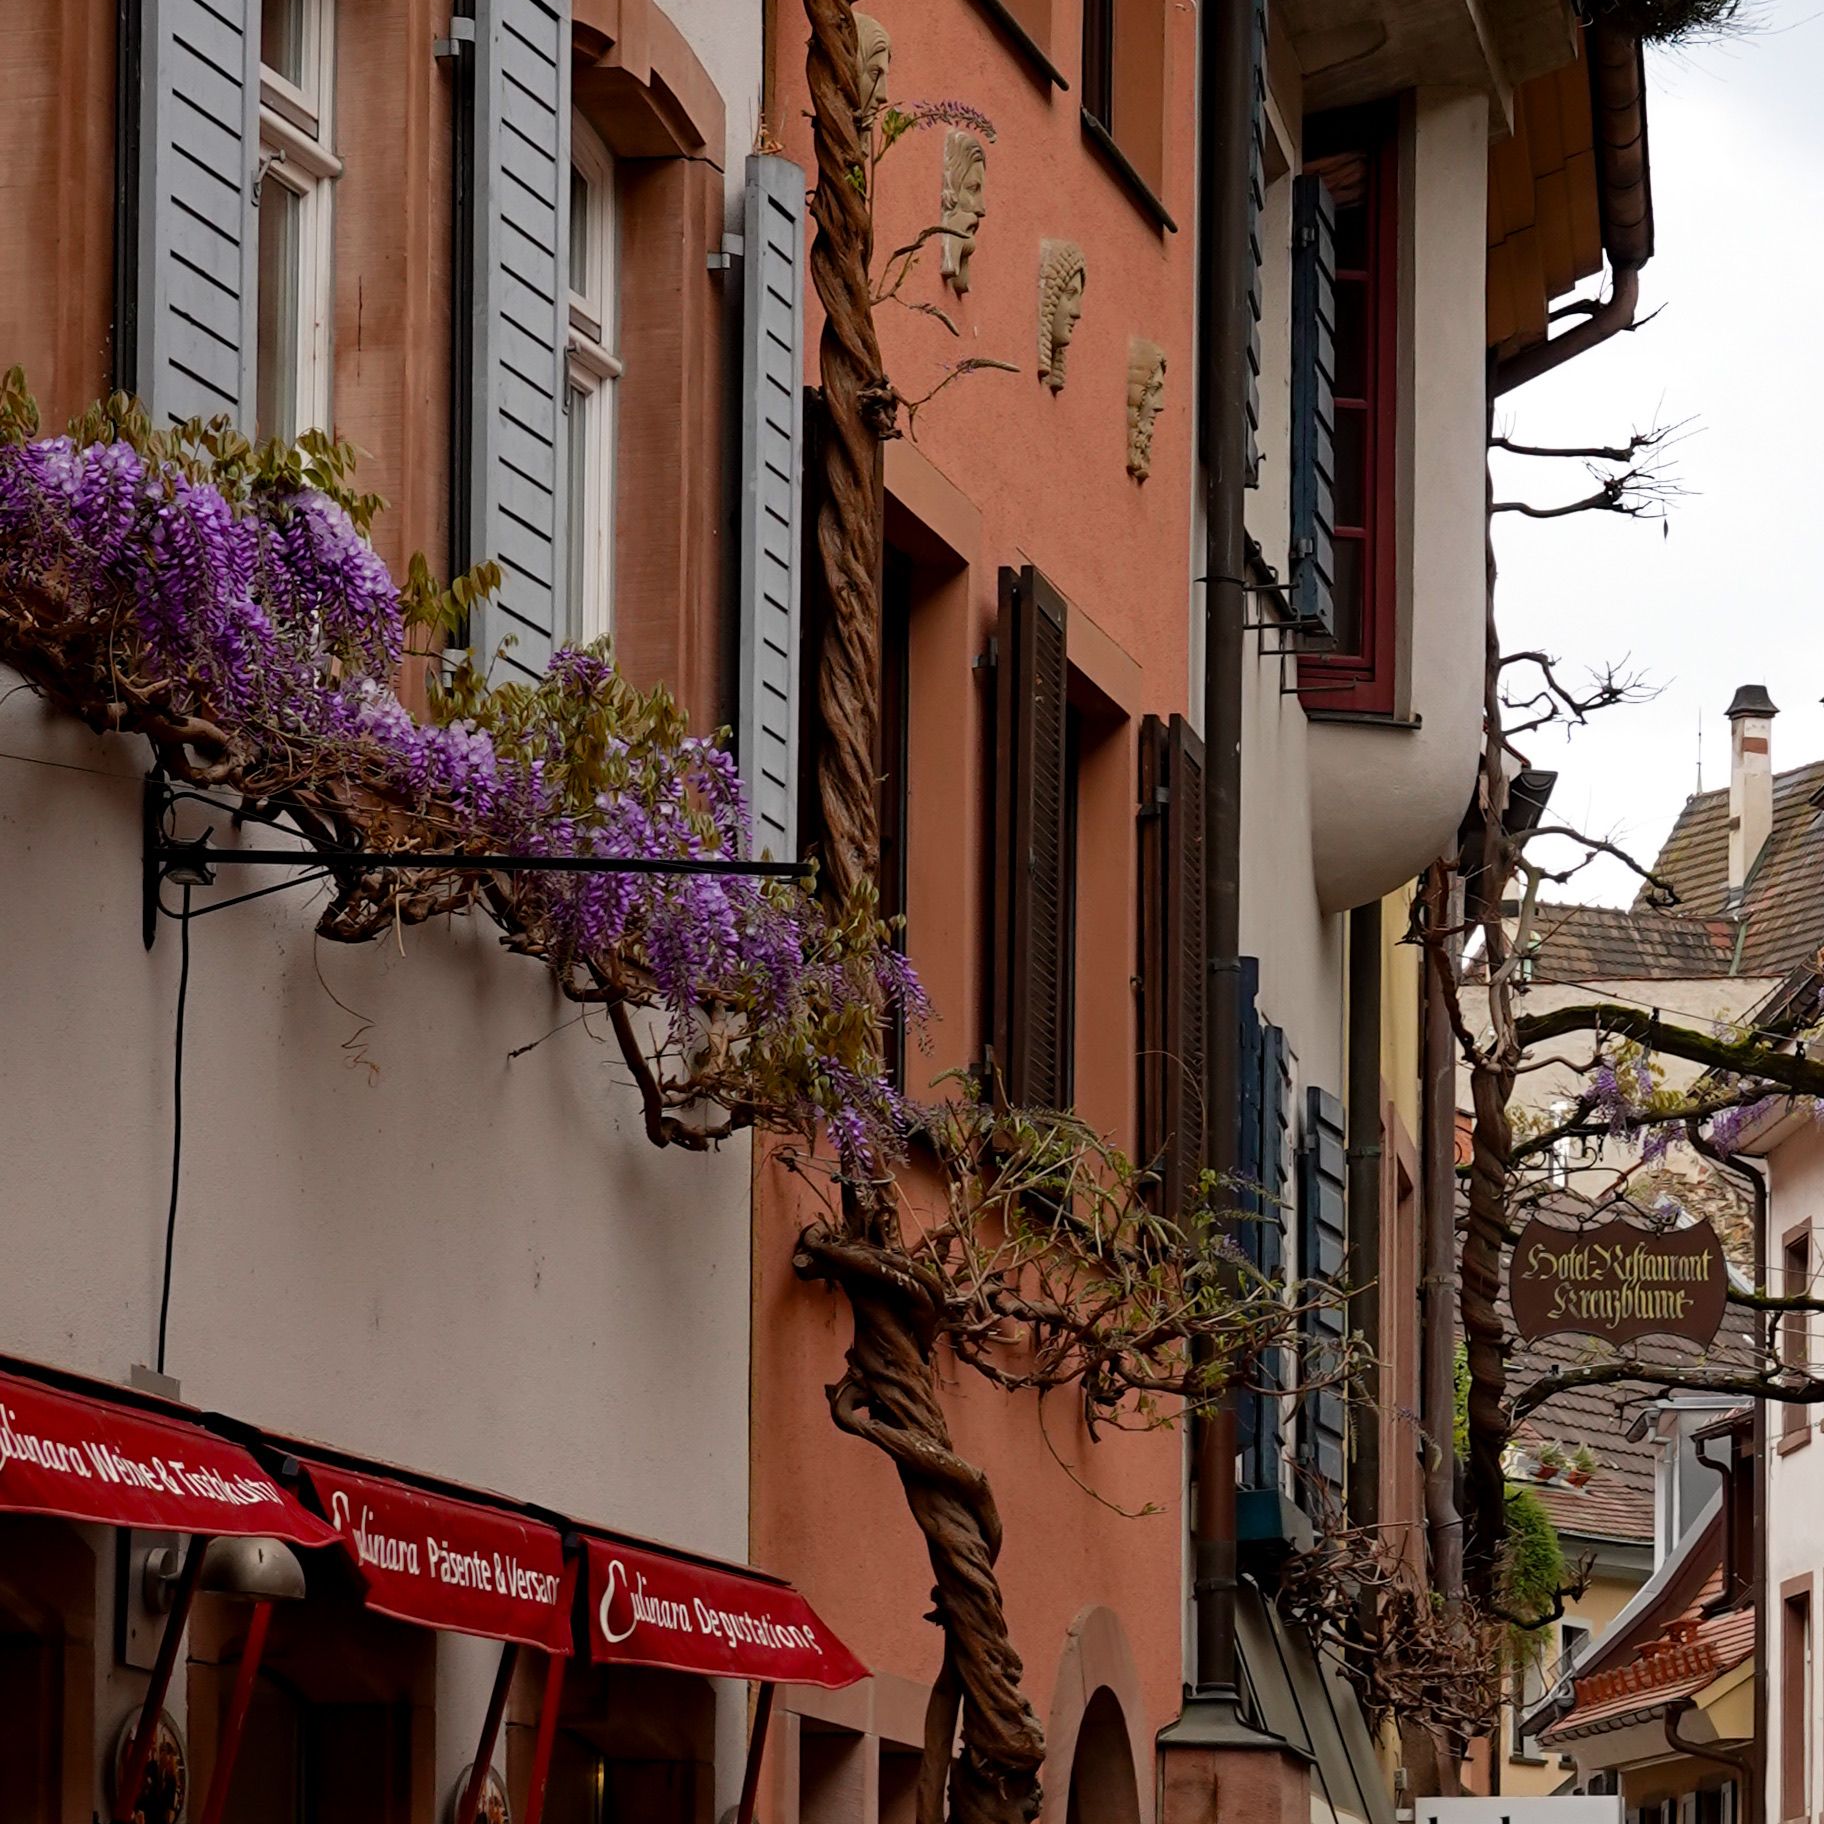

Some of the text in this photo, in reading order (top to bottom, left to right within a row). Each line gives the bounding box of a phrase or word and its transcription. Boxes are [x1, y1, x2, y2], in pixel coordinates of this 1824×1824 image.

[1546, 1280, 1694, 1329] Kreuzblume
[0, 1403, 92, 1478] ulinara
[152, 1457, 185, 1495] &
[493, 1552, 508, 1595] &
[600, 1560, 692, 1643] Culinara
